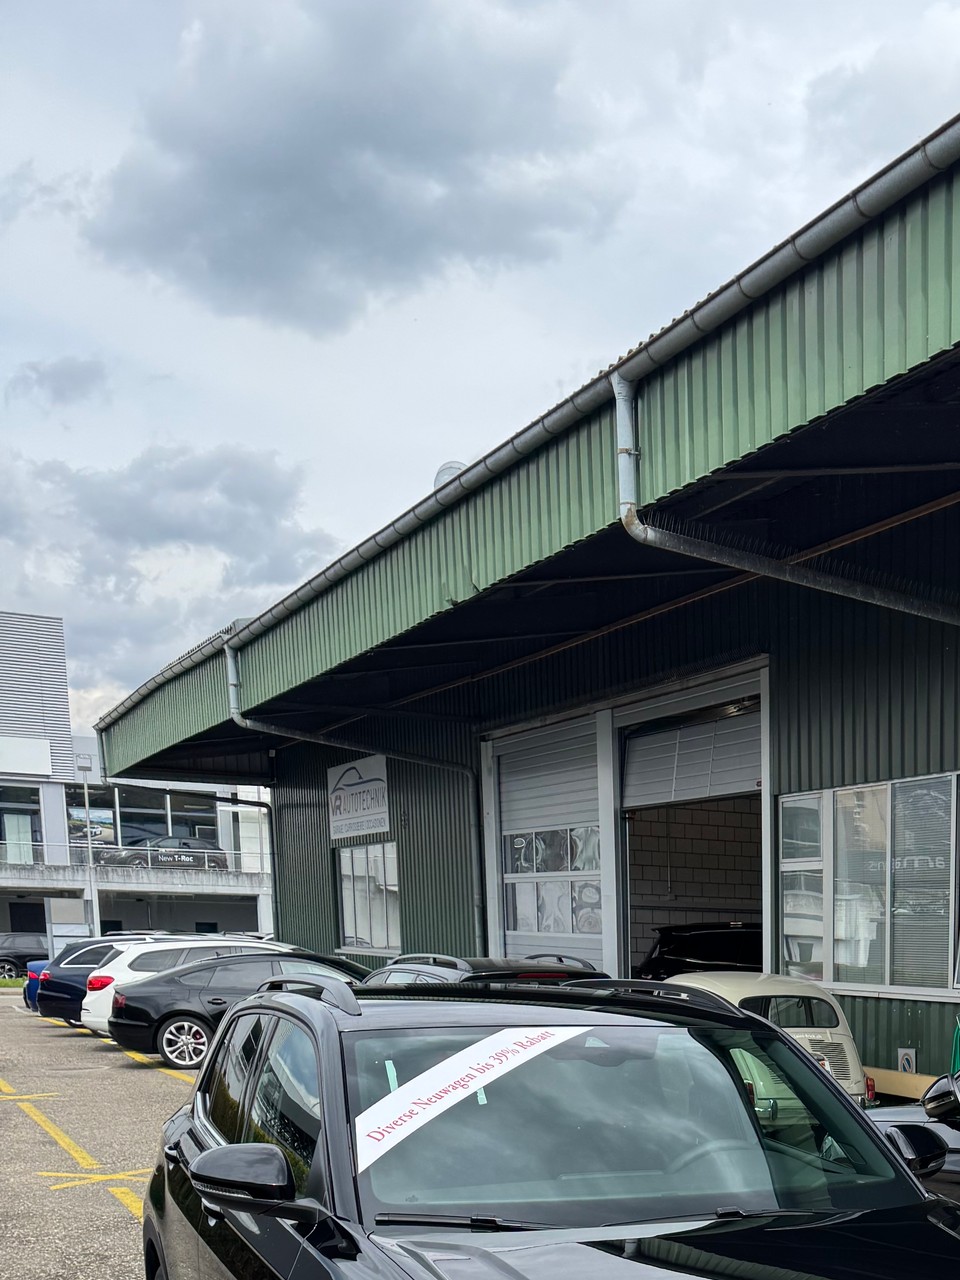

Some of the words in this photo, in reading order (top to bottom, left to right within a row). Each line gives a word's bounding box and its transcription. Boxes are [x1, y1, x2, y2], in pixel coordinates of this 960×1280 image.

[343, 786, 387, 814] AUTOTECHNIK
[174, 854, 194, 862] T-Roc
[366, 1108, 419, 1142] Diverse
[411, 1072, 477, 1110] Neuwagen
[469, 1062, 495, 1075] bis
[488, 1046, 520, 1065] 39%
[512, 1030, 556, 1050] Rabatt
